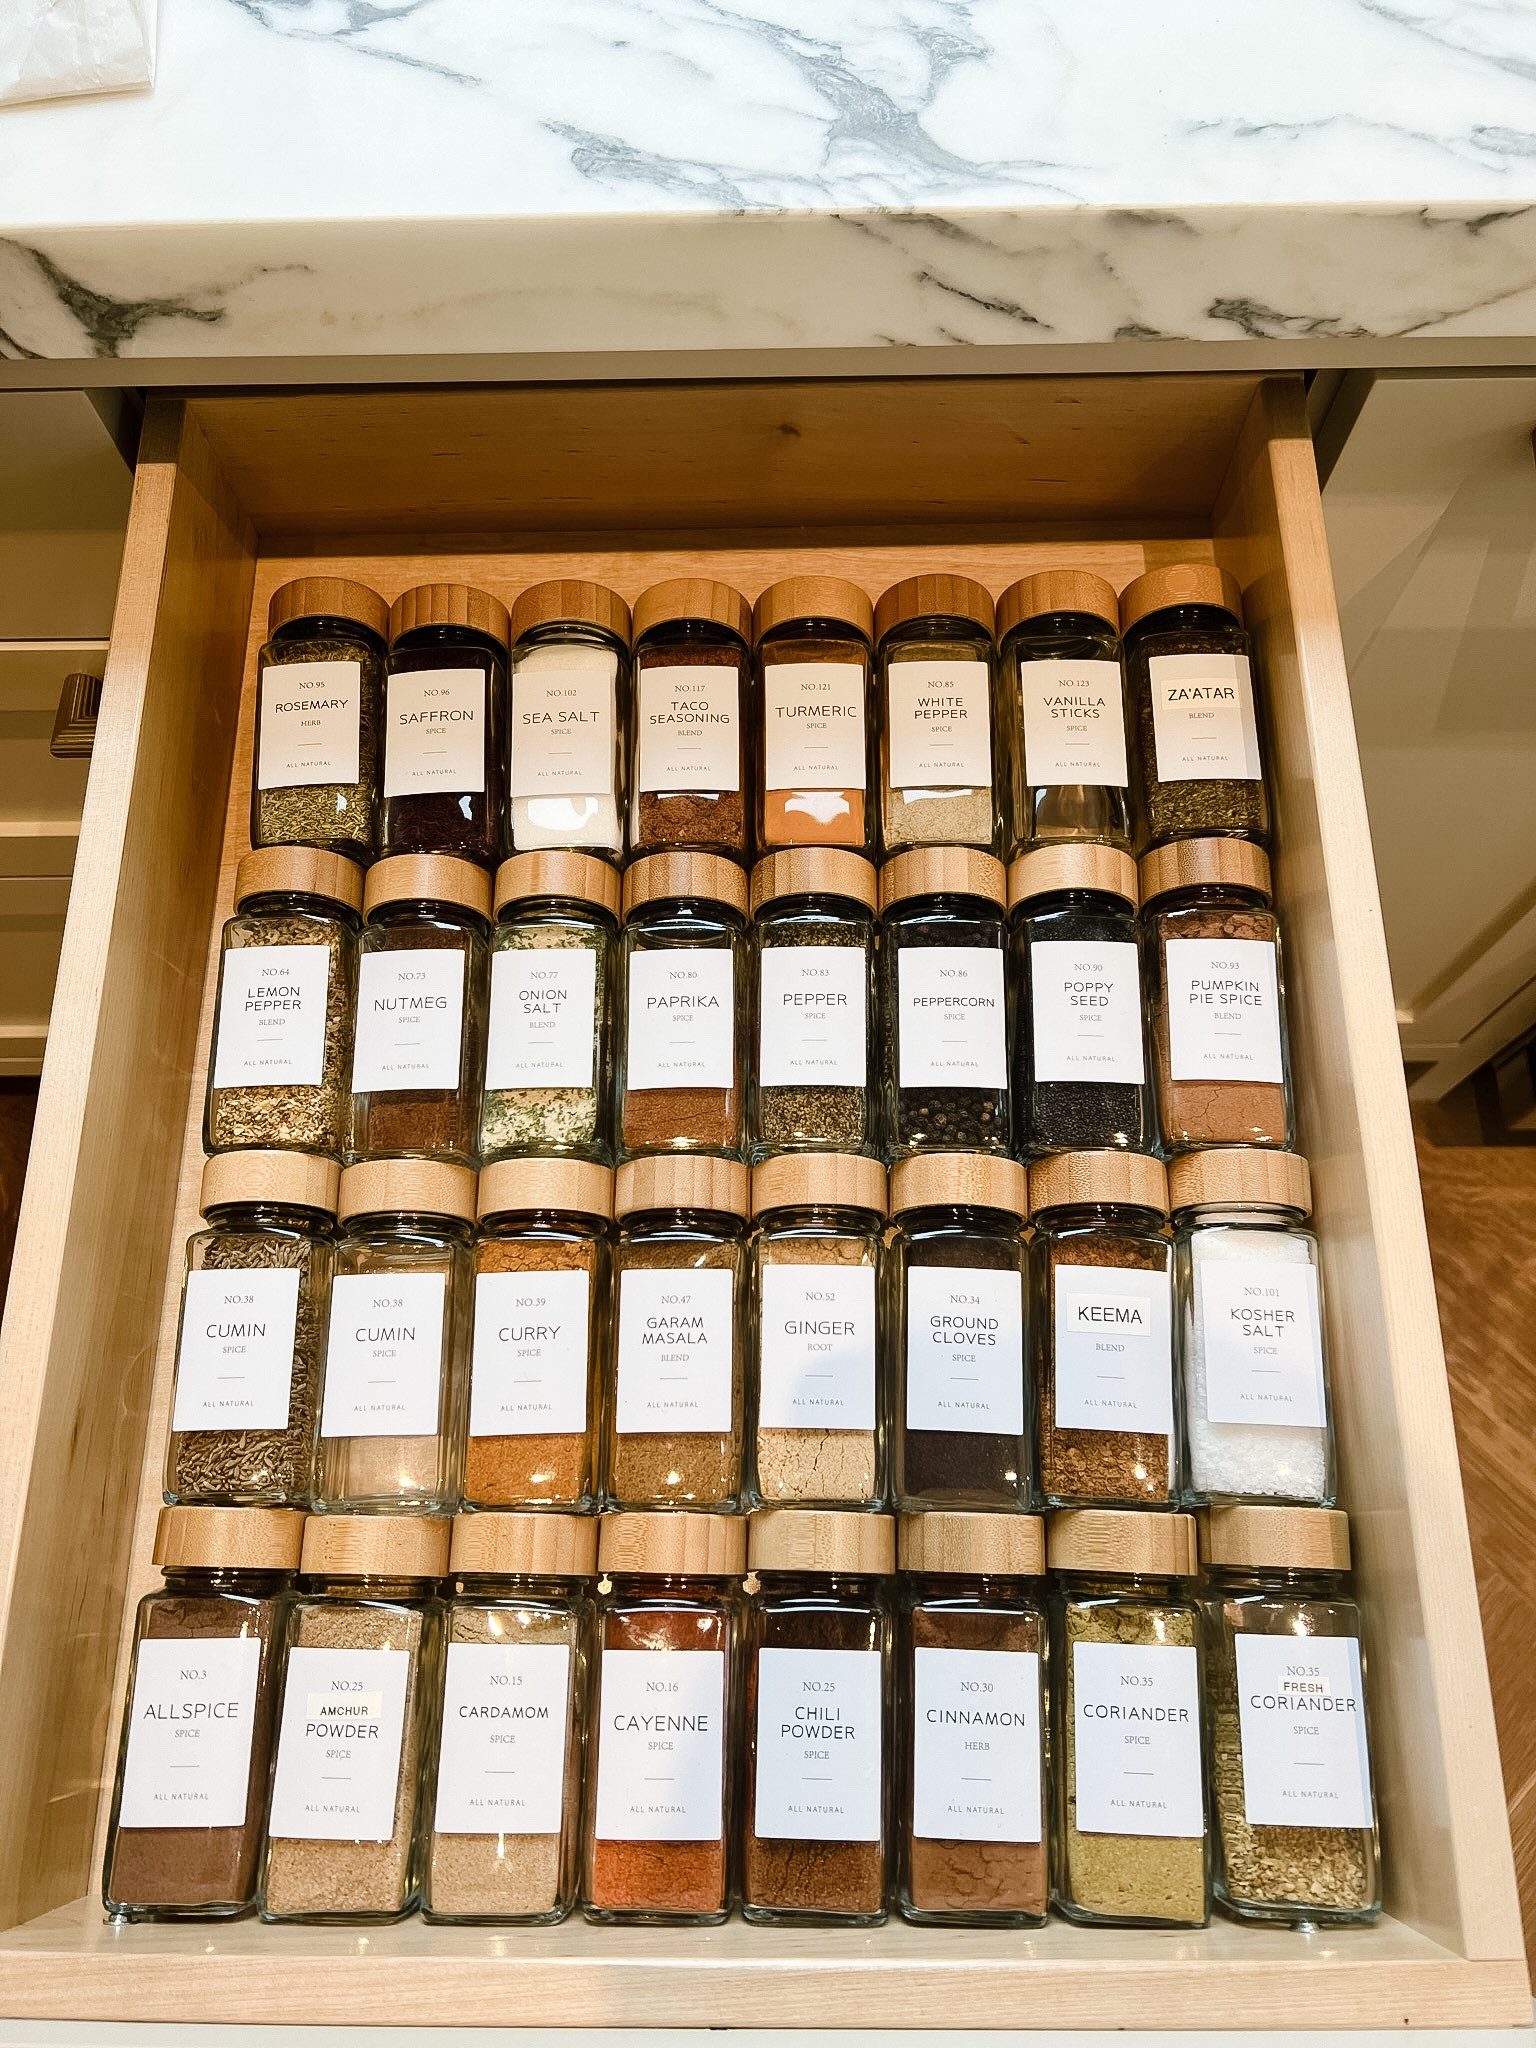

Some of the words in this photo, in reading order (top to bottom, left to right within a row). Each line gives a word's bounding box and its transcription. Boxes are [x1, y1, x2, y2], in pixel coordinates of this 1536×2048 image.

[299, 681, 325, 689] NO.95
[927, 680, 954, 688] NO.85
[546, 689, 576, 697] NO.102
[1167, 687, 1234, 700] ZA'ATAR
[275, 699, 348, 713] ROSEMARY
[670, 701, 708, 710] TACO
[917, 697, 962, 706] WHITE
[1043, 696, 1105, 706] VANILLA
[775, 705, 856, 717] TURMERIC
[914, 709, 967, 719] PEPPER
[1050, 708, 1099, 718] STICKS
[399, 710, 473, 724] SAFFRON
[522, 712, 552, 724] SEA
[558, 711, 599, 722] SALT
[649, 713, 729, 724] SEASONING
[1074, 963, 1103, 971] NO.90
[1211, 961, 1239, 969] NO.93
[261, 968, 289, 976] NO.64
[398, 972, 425, 980] NO.73
[530, 971, 558, 979] NO.77
[669, 971, 697, 979] NO.80
[801, 968, 829, 976] NO.83
[939, 969, 967, 977] NO.86
[1064, 981, 1113, 992] POPPY
[1191, 980, 1258, 991] PUMPKIN
[248, 986, 299, 998] LEMON
[518, 989, 566, 1000] ONION
[374, 996, 446, 1011] NUTMEG
[647, 995, 719, 1009] PAPRIKA
[783, 993, 847, 1005] PEPPER
[913, 997, 994, 1007] PEPPERCORN
[1070, 995, 1108, 1006] SEED
[1189, 993, 1213, 1003] PIE
[1219, 993, 1261, 1005] SPICE
[244, 999, 301, 1011] PEPPER
[523, 1003, 561, 1013] SALT
[806, 1292, 835, 1301] NO.52
[1244, 1287, 1279, 1296] NO.101
[224, 1295, 253, 1304] NO.38
[373, 1299, 403, 1307] NO.38
[516, 1297, 545, 1307] NO.39
[661, 1295, 691, 1304] NO.47
[950, 1294, 979, 1304] NO.34
[1078, 1306, 1142, 1323] KEEMA
[1230, 1308, 1294, 1322] KOSHER
[646, 1317, 703, 1328] GARAM
[930, 1315, 998, 1329] GROUND
[206, 1323, 265, 1337] CUMIN
[784, 1320, 854, 1335] GINGER
[1242, 1324, 1284, 1337] SALT
[355, 1327, 415, 1341] CUMIN
[498, 1326, 560, 1341] CURRY
[641, 1332, 707, 1344] MASALA
[932, 1331, 995, 1345] CLOVES
[222, 1345, 246, 1353] SPICE
[517, 1348, 541, 1356] SPICE
[807, 1343, 832, 1351] ROOT
[1095, 1343, 1124, 1351] BLEND
[1253, 1346, 1277, 1354] SPICE
[372, 1349, 396, 1357] SPICE
[952, 1353, 976, 1362] SPICE
[1101, 1400, 1136, 1408] NATURAL
[180, 1670, 206, 1679] NO.3
[1286, 1665, 1319, 1676] NO.35
[490, 1675, 522, 1685] NO.15
[1120, 1675, 1153, 1686] NO.35
[331, 1680, 363, 1691] NO.25
[646, 1682, 678, 1691] NO.16
[802, 1681, 835, 1692] NO.25
[960, 1681, 993, 1692] NO.30
[1283, 1681, 1323, 1692] FRESH
[1250, 1695, 1356, 1711] CORIANDER
[143, 1702, 238, 1719] ALLSPICE
[320, 1706, 368, 1715] AMCHUR
[459, 1705, 548, 1718] CARDAMOM
[795, 1706, 839, 1720] CHILI
[1083, 1704, 1188, 1722] CORIANDER
[926, 1709, 1024, 1726] CINNAMON
[614, 1715, 708, 1731] CAYENNE
[174, 1729, 200, 1737] SPICE
[305, 1723, 378, 1738] POWDER
[781, 1724, 854, 1739] POWDER
[1293, 1726, 1319, 1735] SPICE
[489, 1734, 515, 1743] SPICE
[1124, 1735, 1150, 1744] SPICE
[648, 1741, 673, 1750] SPICE
[964, 1741, 989, 1750] HERB
[325, 1749, 351, 1758] SPICE
[804, 1750, 829, 1759] SPICE
[322, 1805, 359, 1813] NATURAL
[629, 1805, 644, 1813] ALL
[806, 1805, 843, 1813] NATURAL
[1129, 1800, 1166, 1808] NATURAL
[966, 1806, 1004, 1814] NATURAL
